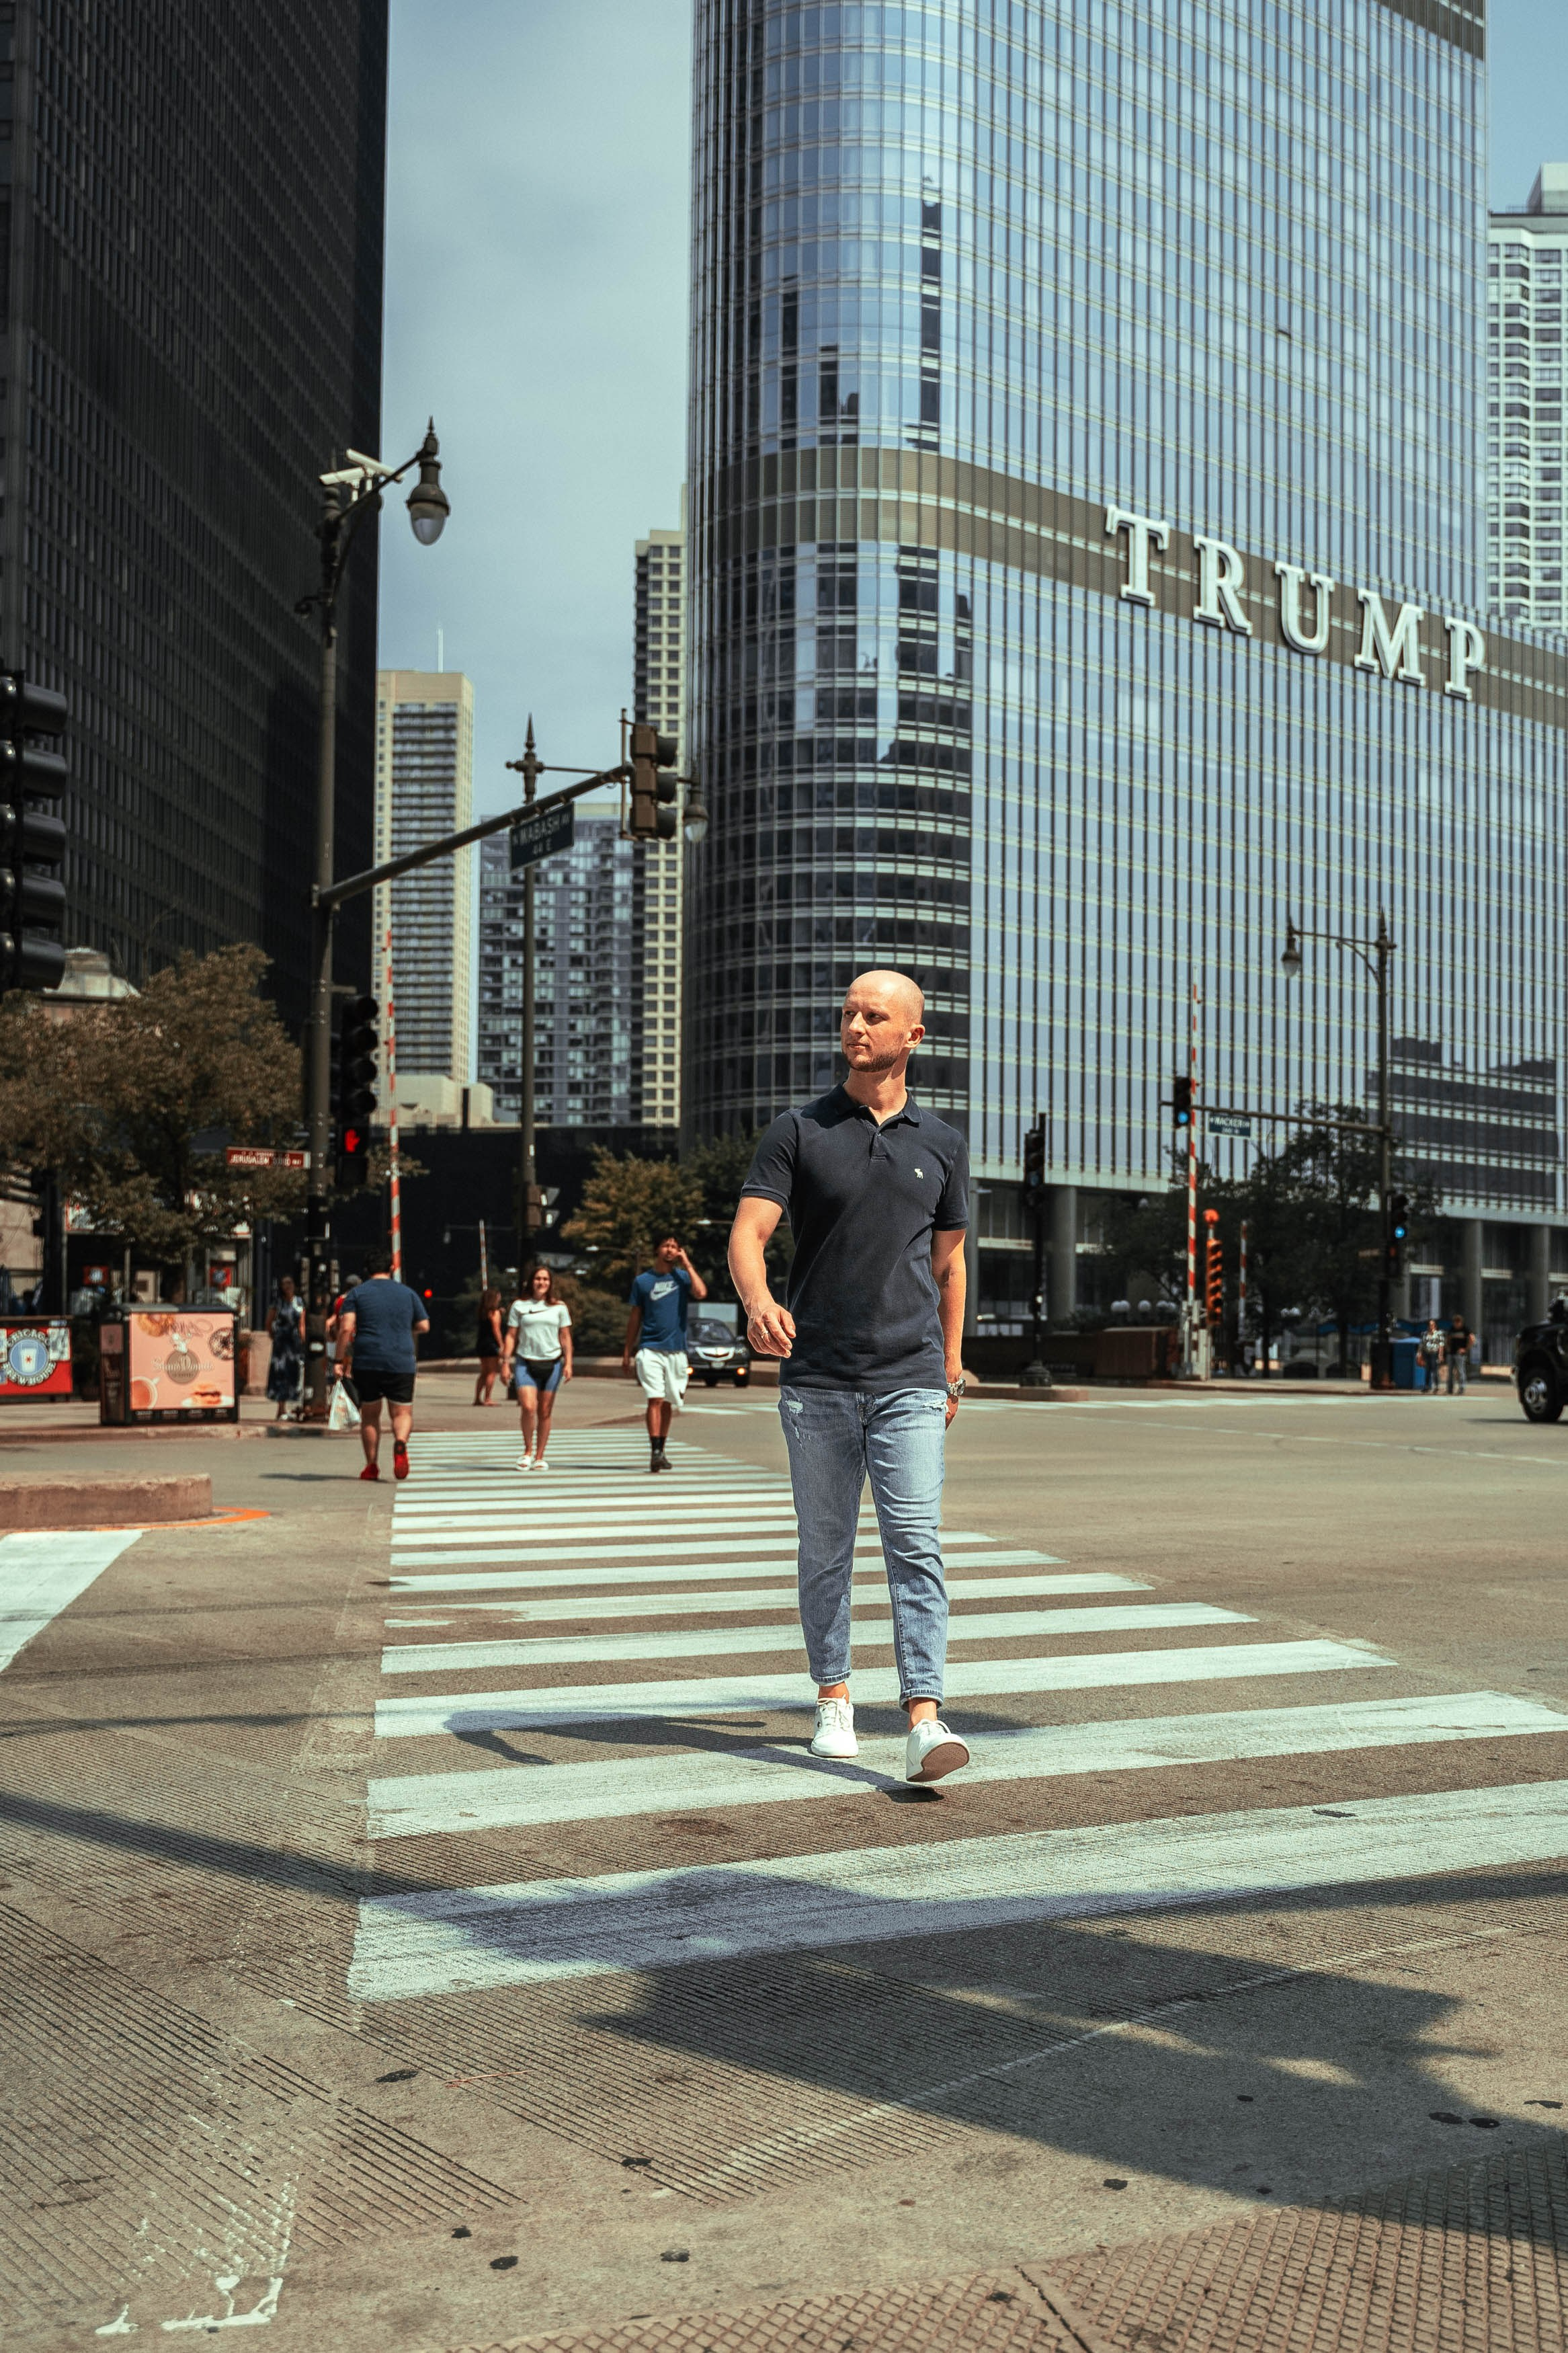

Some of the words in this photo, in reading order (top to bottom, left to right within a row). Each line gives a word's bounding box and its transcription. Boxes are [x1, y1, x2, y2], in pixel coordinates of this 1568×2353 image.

[1106, 504, 1485, 701] TRUMP
[520, 815, 561, 846] WABASH
[1214, 1117, 1242, 1128] WACKER
[231, 1154, 269, 1164] JERUSALEM
[655, 1280, 674, 1292] NIKE
[7, 1328, 51, 1348] CHICAGO
[2, 1361, 57, 1387] BREWHOUSE
